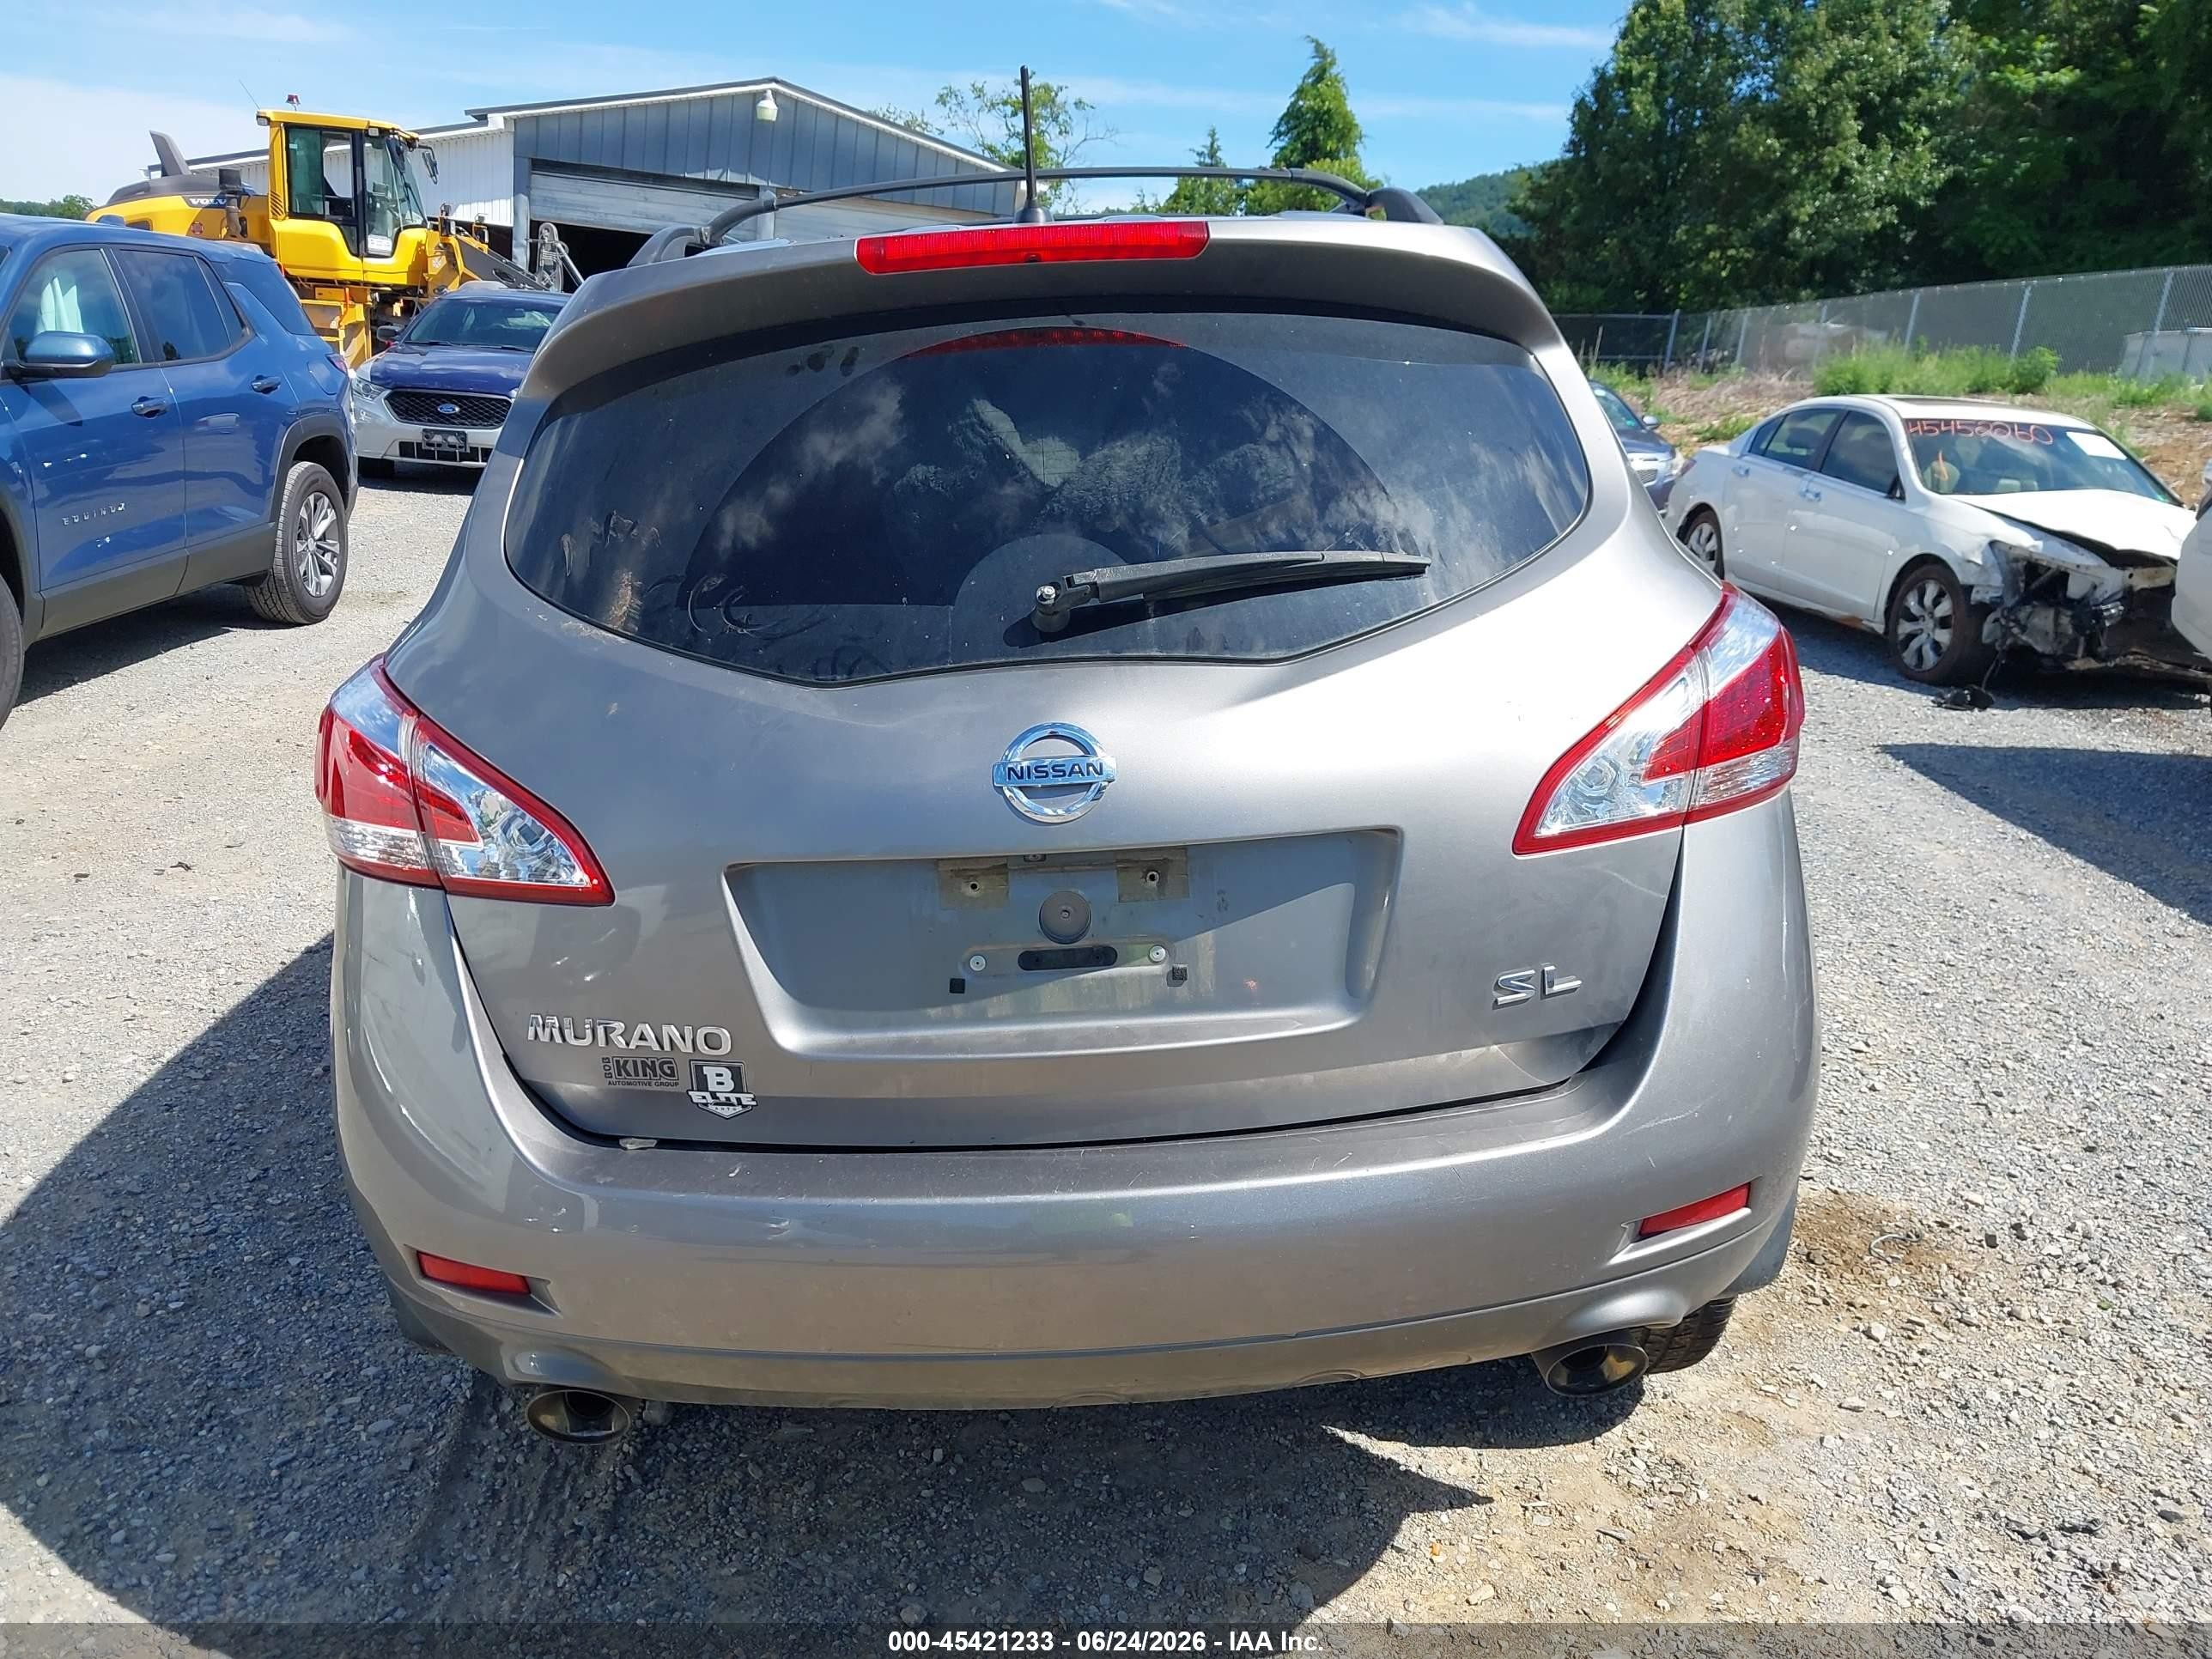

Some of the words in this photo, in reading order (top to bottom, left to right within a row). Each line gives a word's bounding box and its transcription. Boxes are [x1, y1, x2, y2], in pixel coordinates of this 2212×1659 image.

[1006, 762, 1104, 781] NISSAN
[1496, 965, 1583, 1006] SL
[526, 1012, 732, 1056] MURANO
[602, 1056, 613, 1079] BOB
[614, 1058, 677, 1079] KING
[702, 1066, 735, 1092] B
[688, 1091, 757, 1106] ELITE
